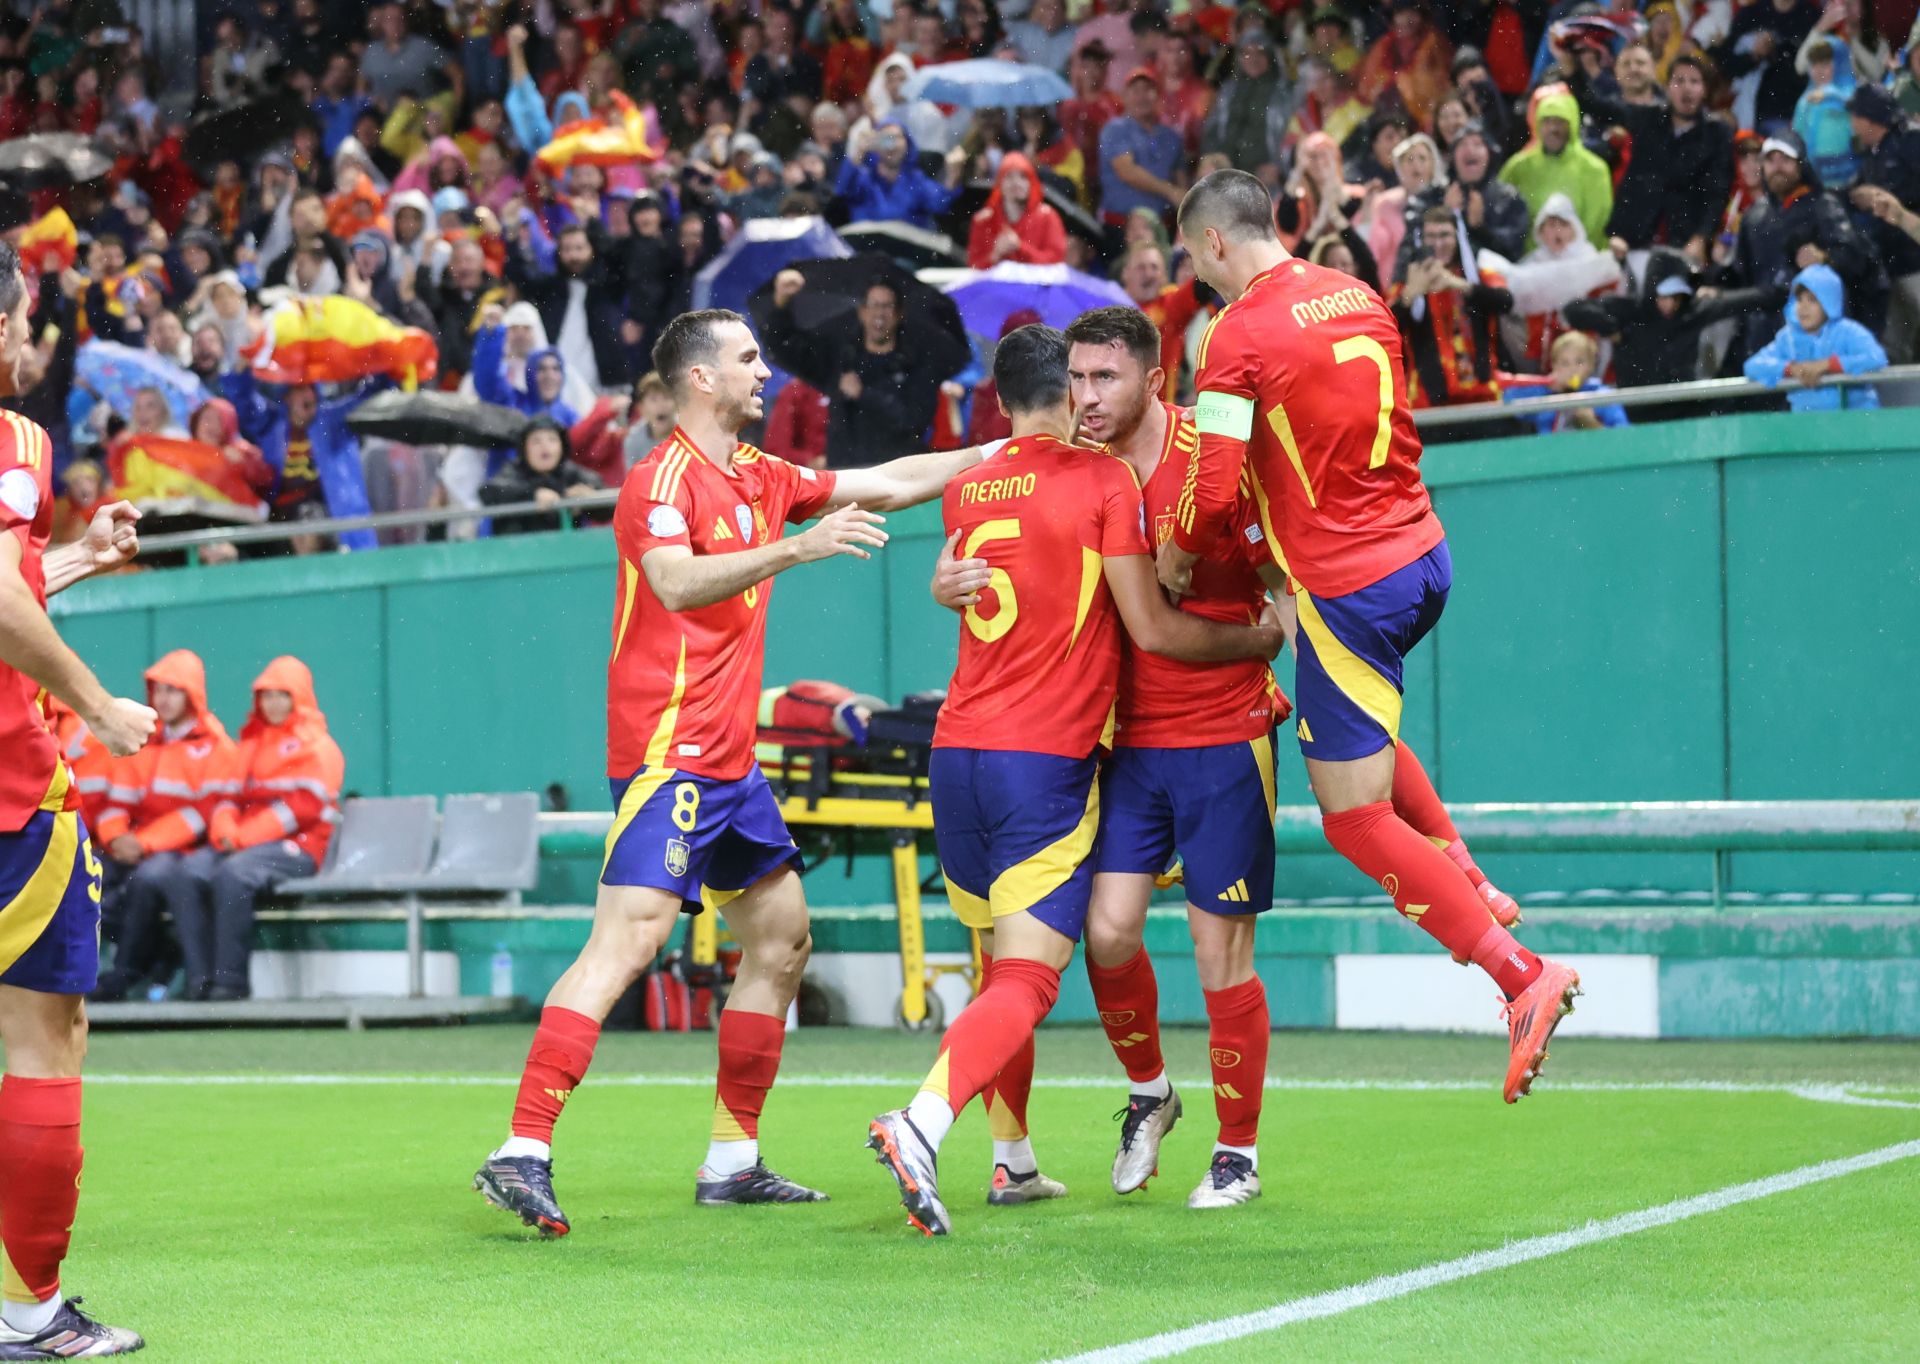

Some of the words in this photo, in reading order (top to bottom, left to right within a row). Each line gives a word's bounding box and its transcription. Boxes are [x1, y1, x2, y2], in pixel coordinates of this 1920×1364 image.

[1291, 287, 1373, 329] MORATA
[1197, 407, 1230, 419] ESPECT
[1332, 334, 1394, 470] 7
[960, 472, 1036, 507] MERINO
[962, 518, 1021, 643] 6
[671, 781, 700, 832] 8
[82, 836, 103, 904] 5
